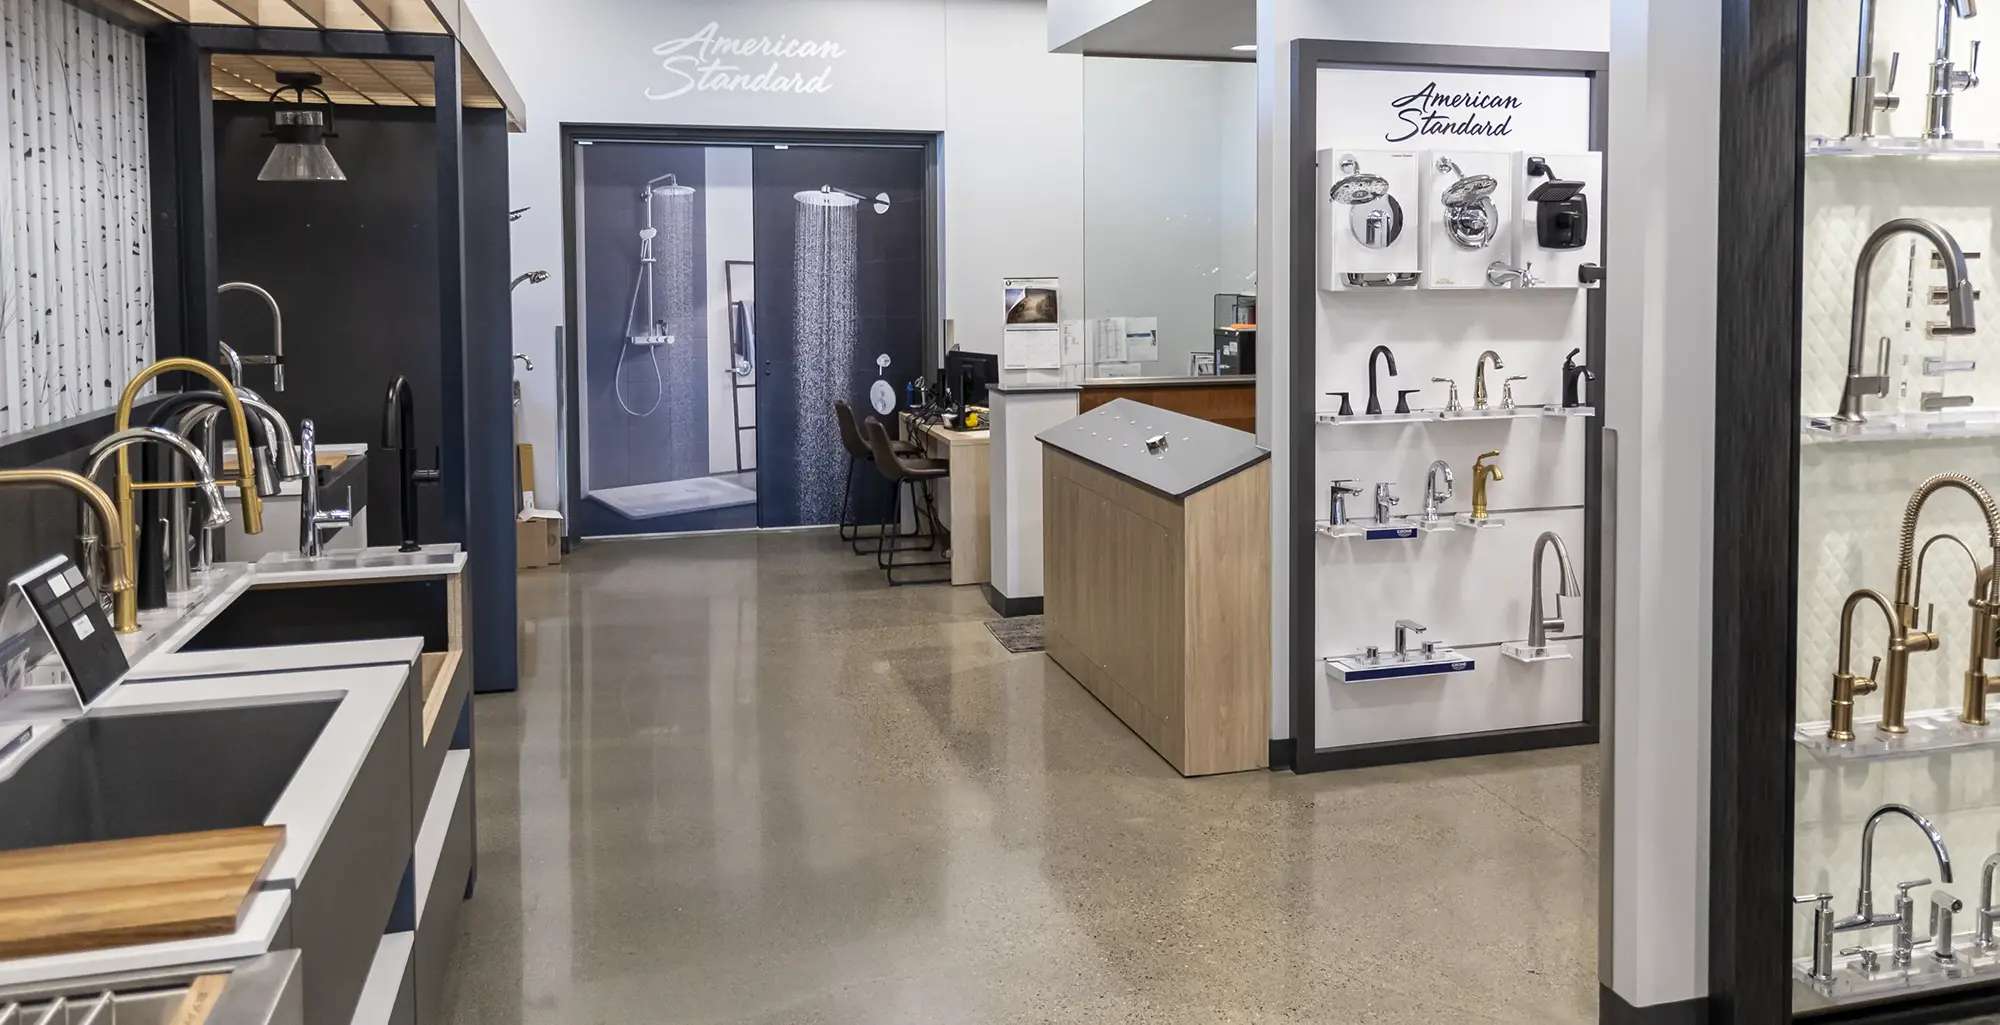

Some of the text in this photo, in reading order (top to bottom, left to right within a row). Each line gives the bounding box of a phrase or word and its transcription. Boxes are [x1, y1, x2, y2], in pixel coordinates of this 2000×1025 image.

[652, 21, 847, 63] American
[644, 54, 833, 100] Standard
[1391, 81, 1522, 113] American
[1385, 107, 1512, 142] Standard
